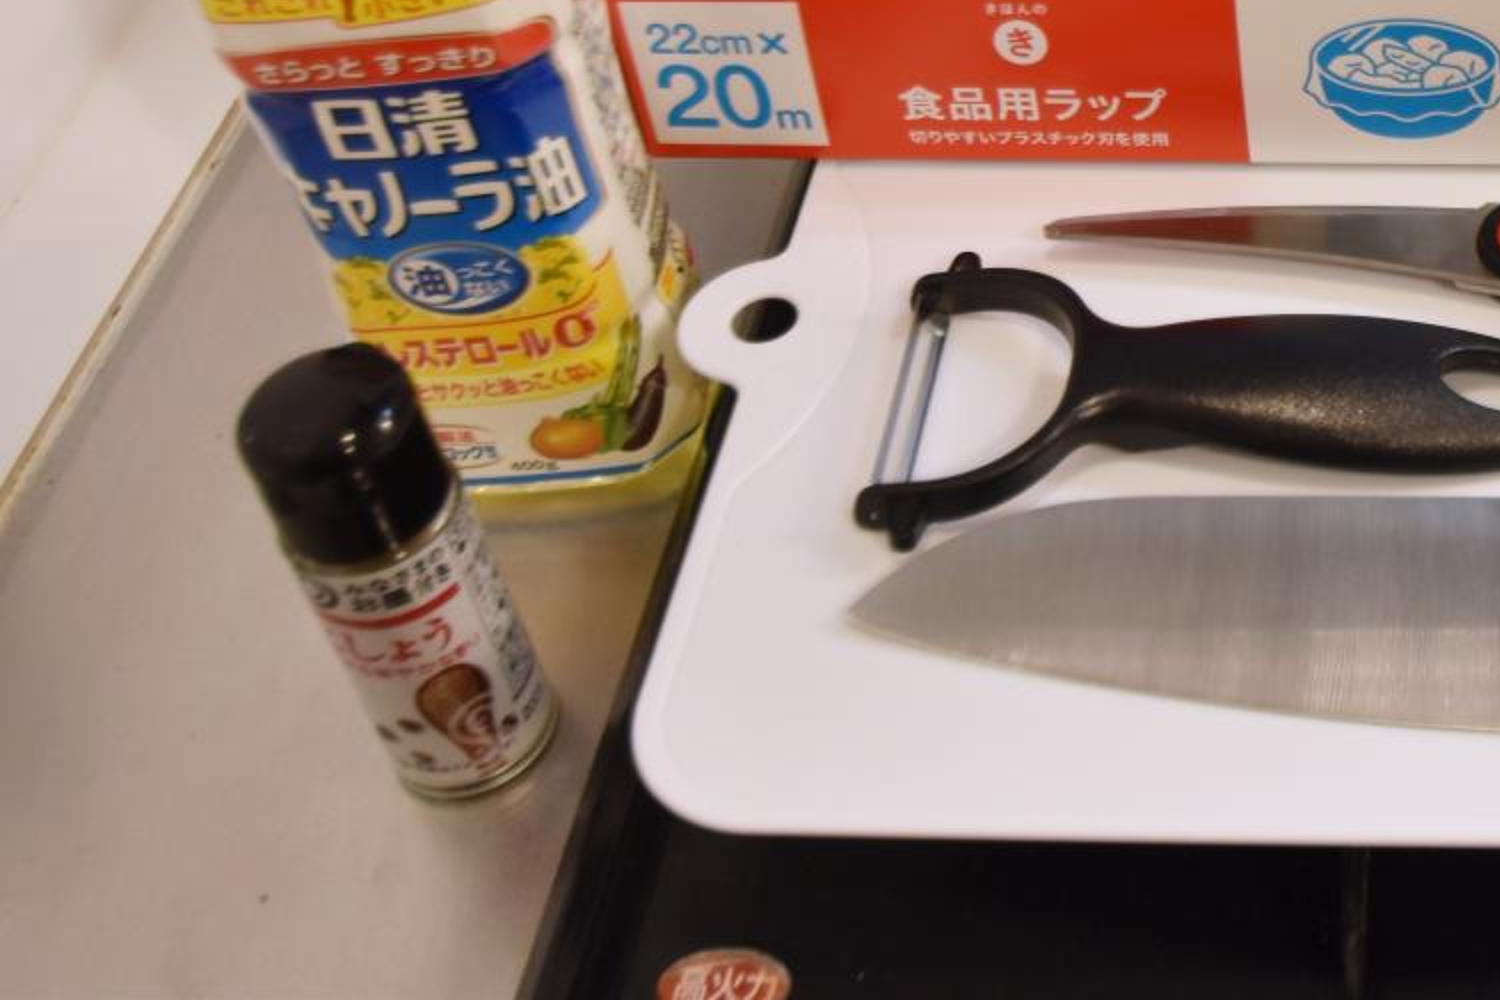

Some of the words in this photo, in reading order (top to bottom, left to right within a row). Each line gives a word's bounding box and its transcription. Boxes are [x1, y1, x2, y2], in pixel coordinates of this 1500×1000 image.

[252, 48, 366, 85] さらっと
[373, 42, 497, 78] すっきり
[656, 62, 813, 131] 20m
[896, 85, 1167, 123] 食品用ラップ
[311, 90, 481, 162] 日清
[908, 129, 1170, 148] 切りやすいプラスチック刃を使用
[384, 312, 596, 368] ステロール0
